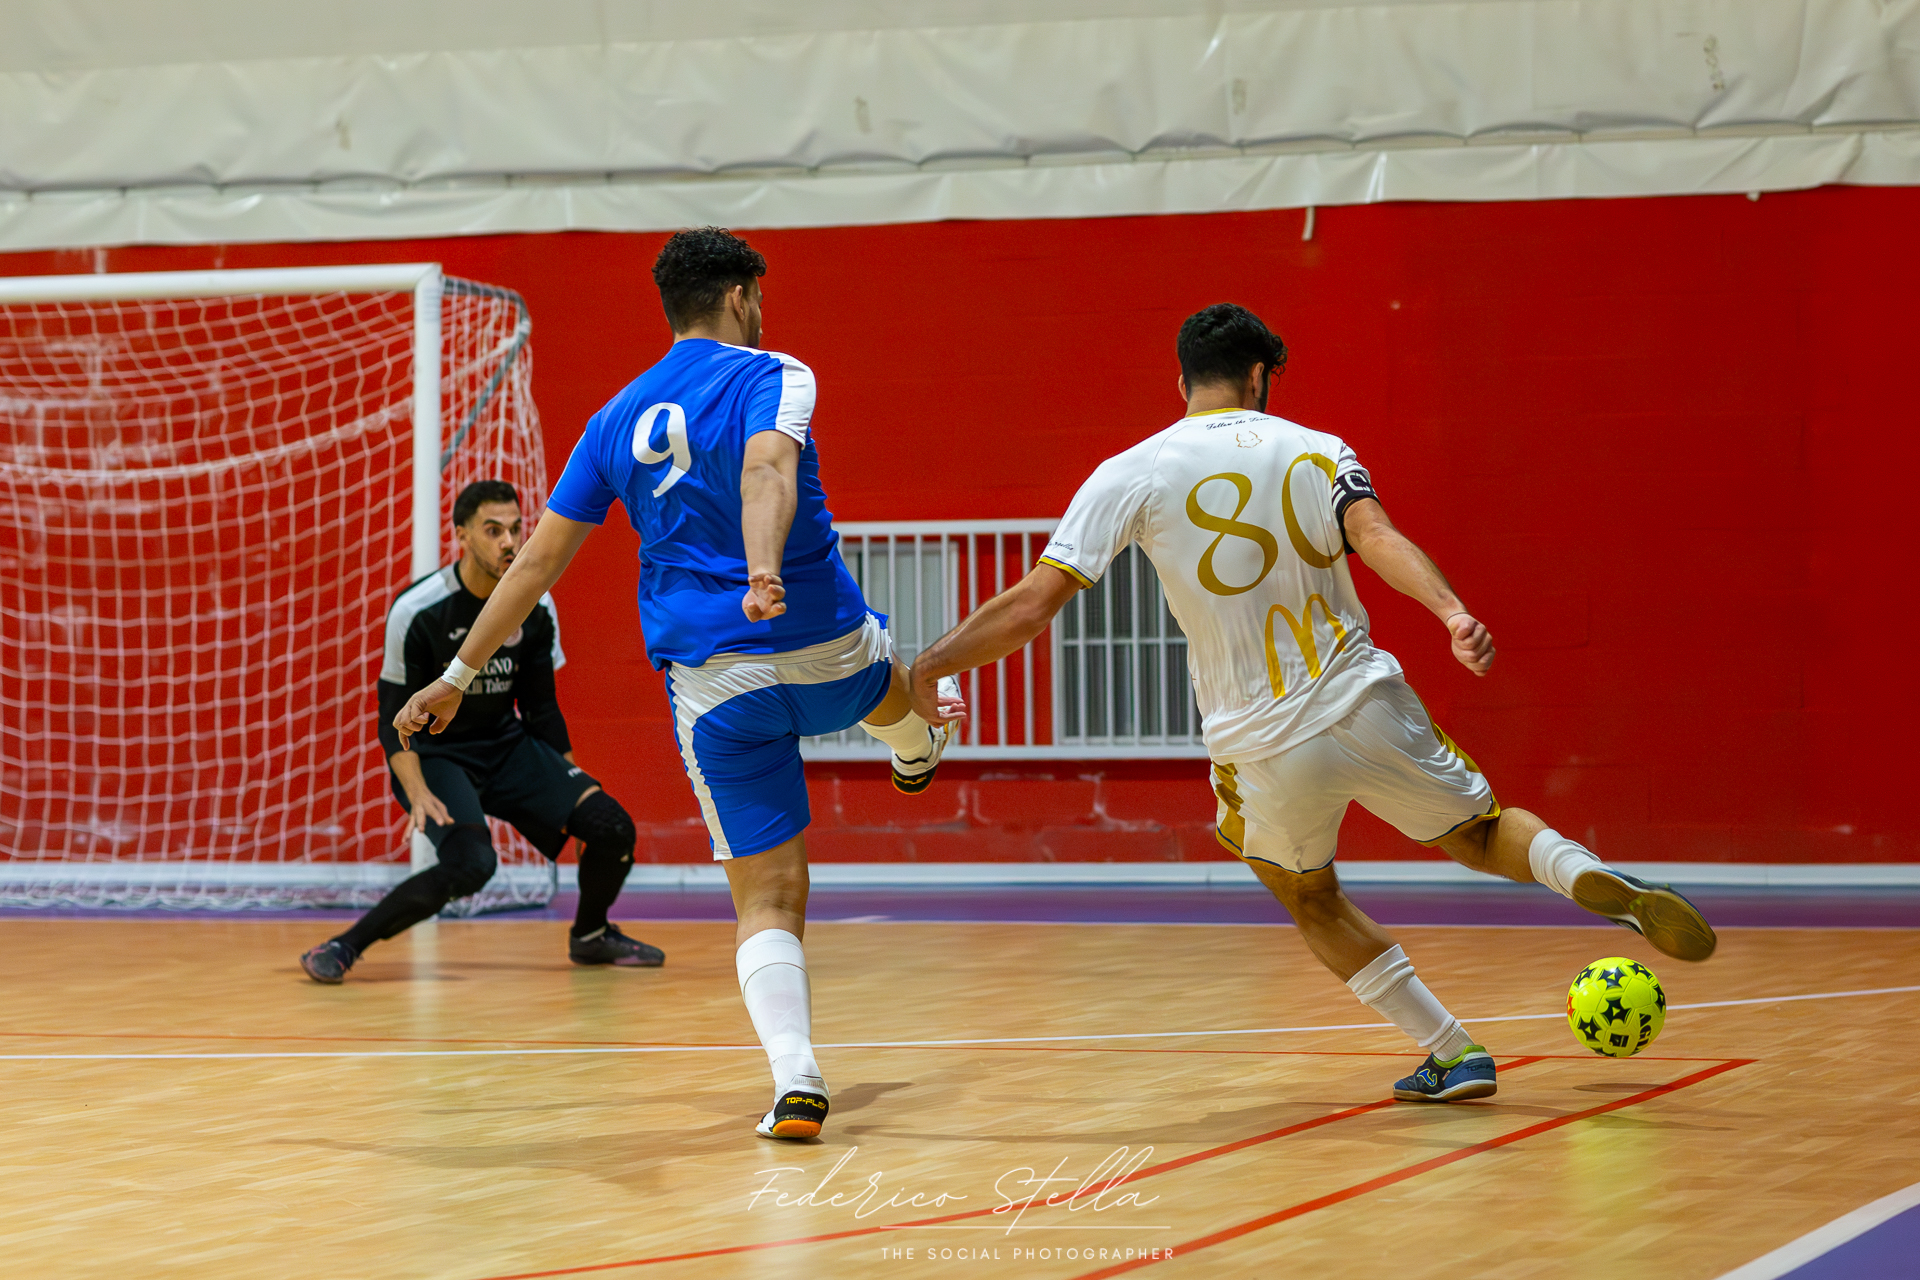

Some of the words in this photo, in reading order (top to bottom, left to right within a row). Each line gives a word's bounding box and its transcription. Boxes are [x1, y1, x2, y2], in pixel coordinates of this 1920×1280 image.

[632, 402, 692, 498] 9
[1206, 422, 1232, 431] Follow
[1185, 452, 1345, 597] 80
[478, 657, 513, 676] GNO
